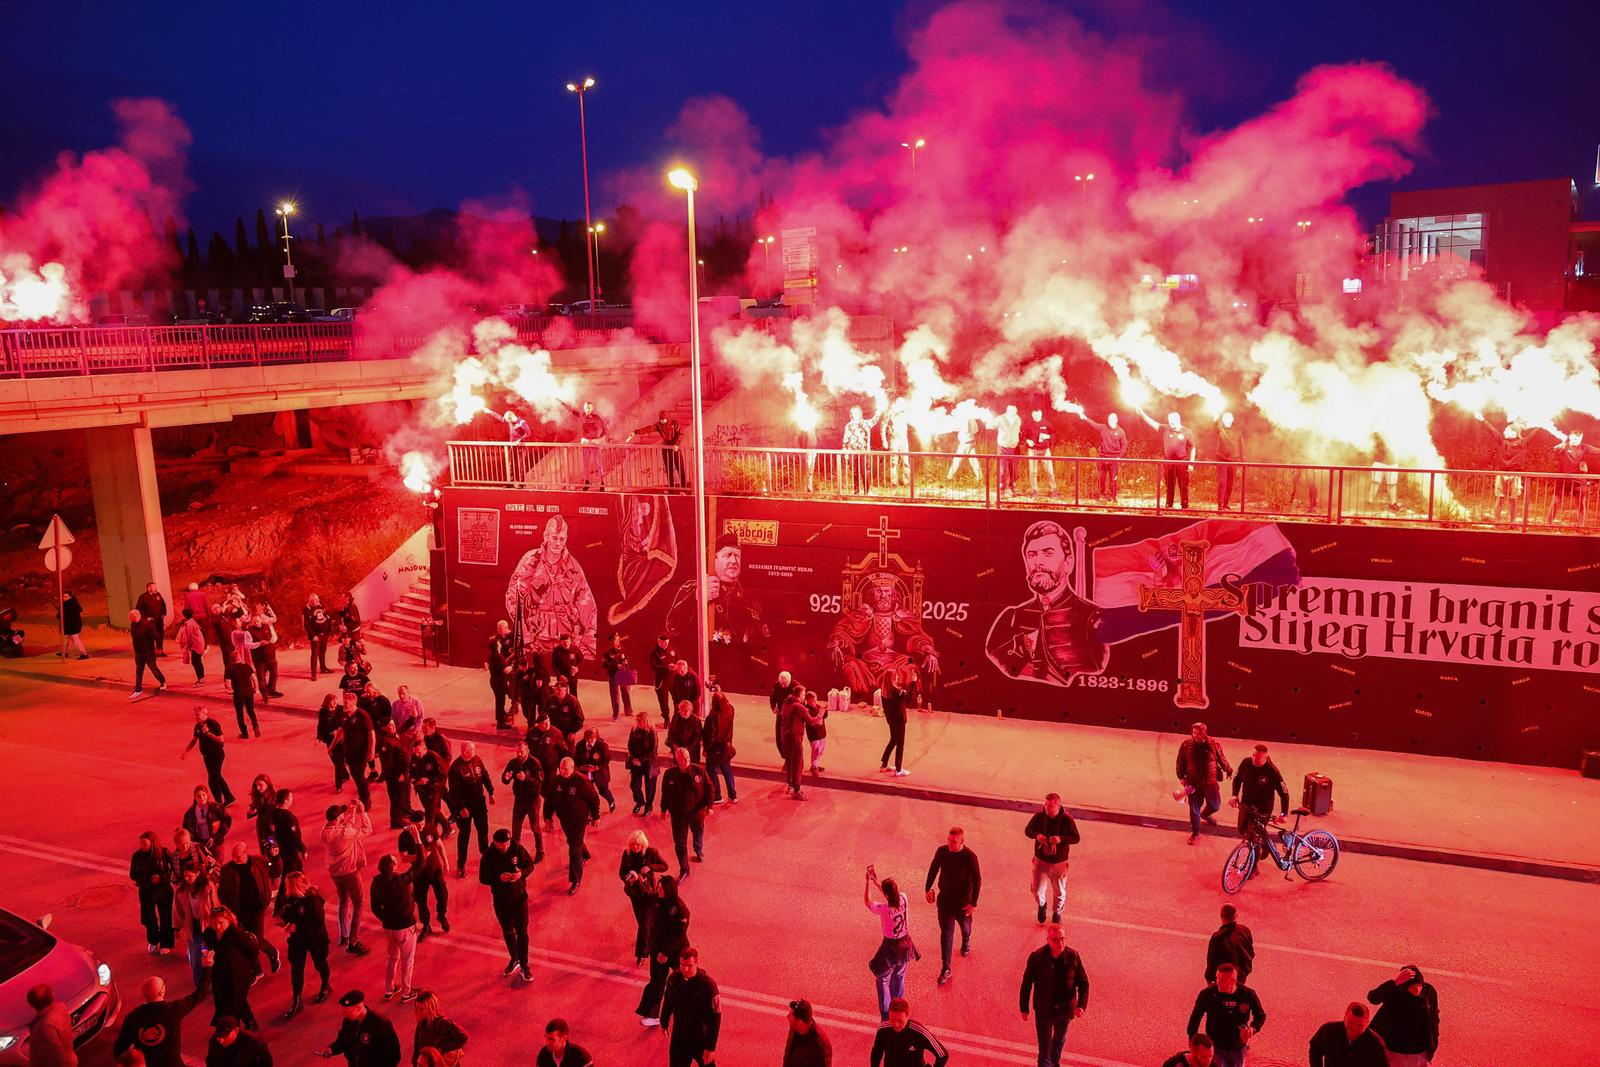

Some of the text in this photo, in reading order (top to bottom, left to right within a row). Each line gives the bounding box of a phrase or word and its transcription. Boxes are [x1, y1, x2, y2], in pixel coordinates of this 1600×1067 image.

[809, 593, 841, 614] 925
[922, 600, 970, 622] 2025
[1220, 573, 1412, 619] Spremni
[1429, 587, 1574, 634] branit
[1244, 610, 1368, 658] Stijeg
[1385, 619, 1536, 664] Hrvata
[1078, 675, 1169, 692] 1823-1896
